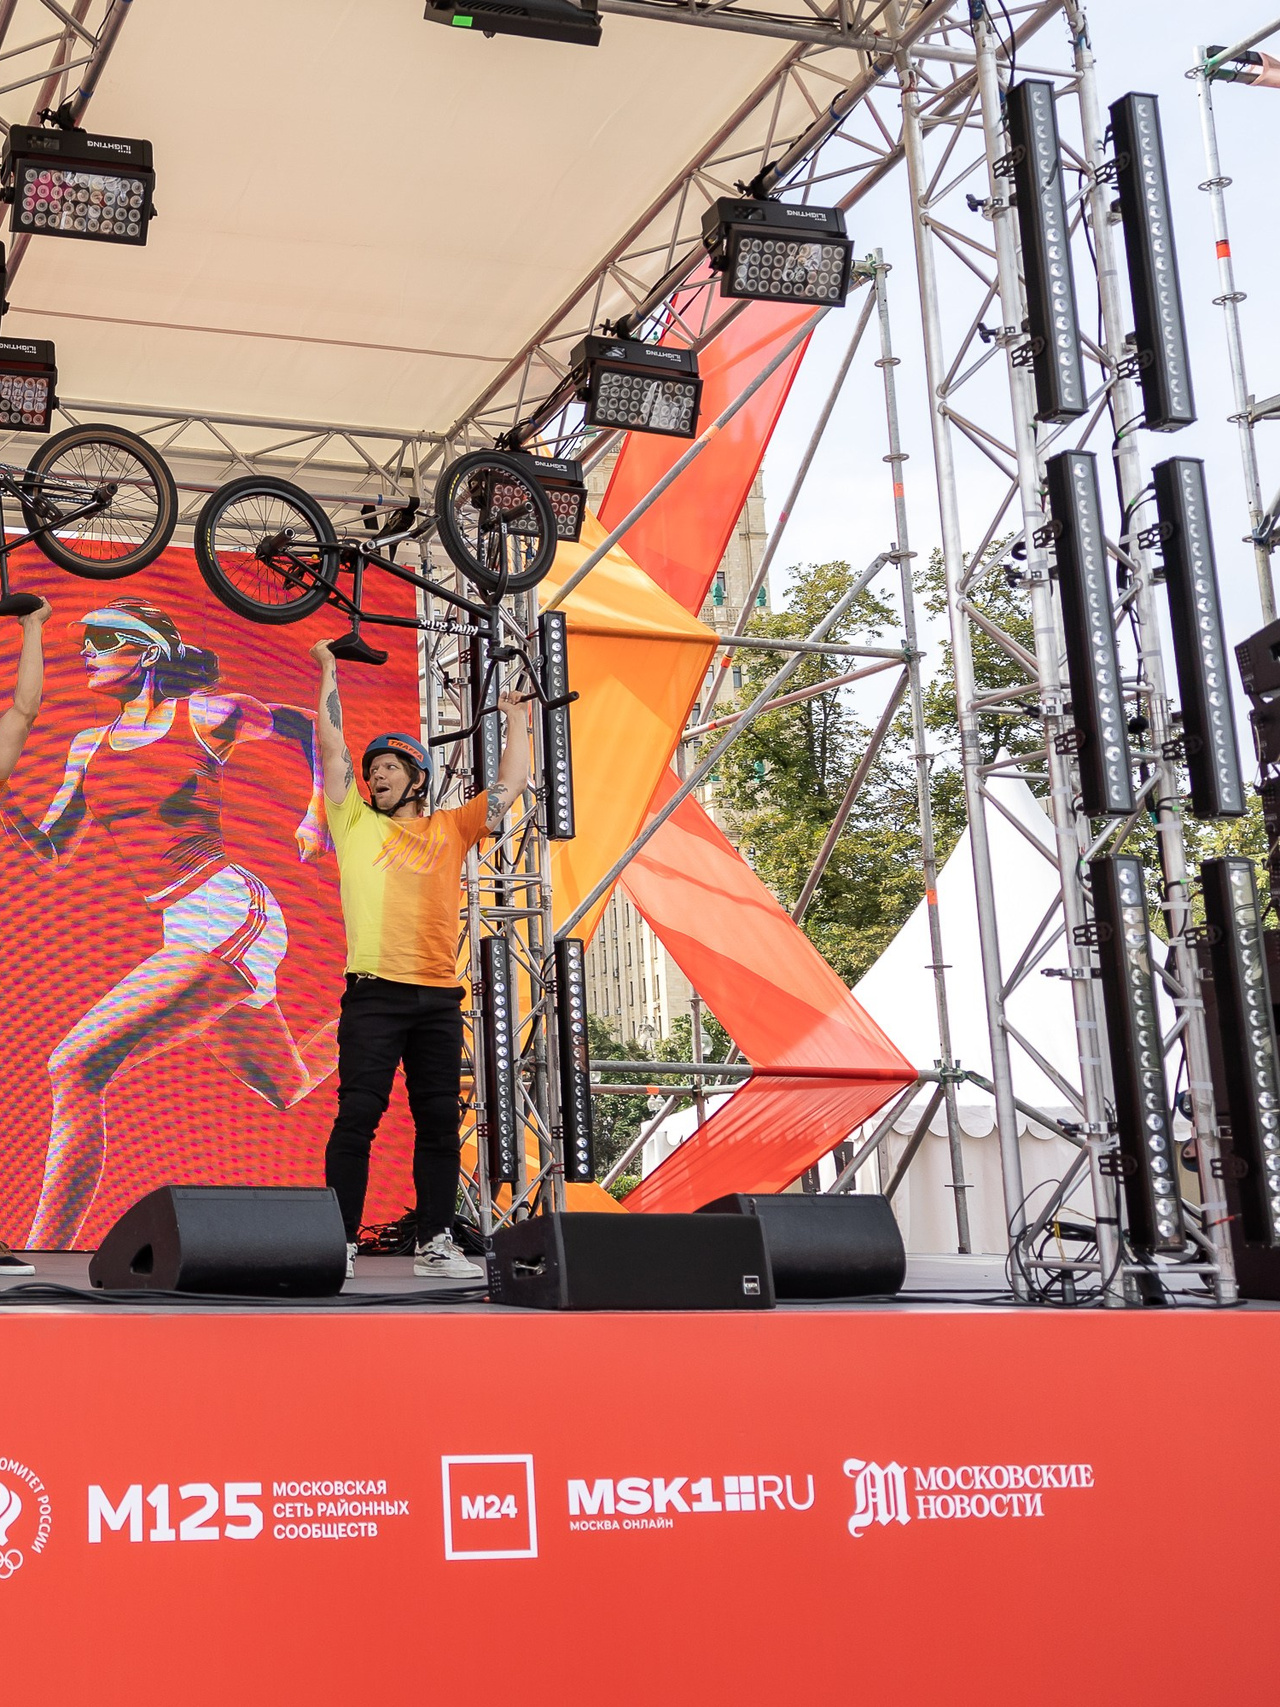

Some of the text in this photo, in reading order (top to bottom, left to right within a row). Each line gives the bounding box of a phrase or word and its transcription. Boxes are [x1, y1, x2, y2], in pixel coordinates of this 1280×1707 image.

[272, 1479, 387, 1498] МОСКОВСКАЯ
[914, 1464, 1095, 1492] МОСКОВСКИЕ
[272, 1498, 410, 1519] СЕТЬ РАЙОННЫХ
[915, 1492, 1045, 1520] НОВОСТИ
[31, 1494, 52, 1554] РОССИИ
[272, 1521, 378, 1541] СООБЩЕСТВ
[569, 1516, 674, 1532] МОСКВА ОНЛАЙН
